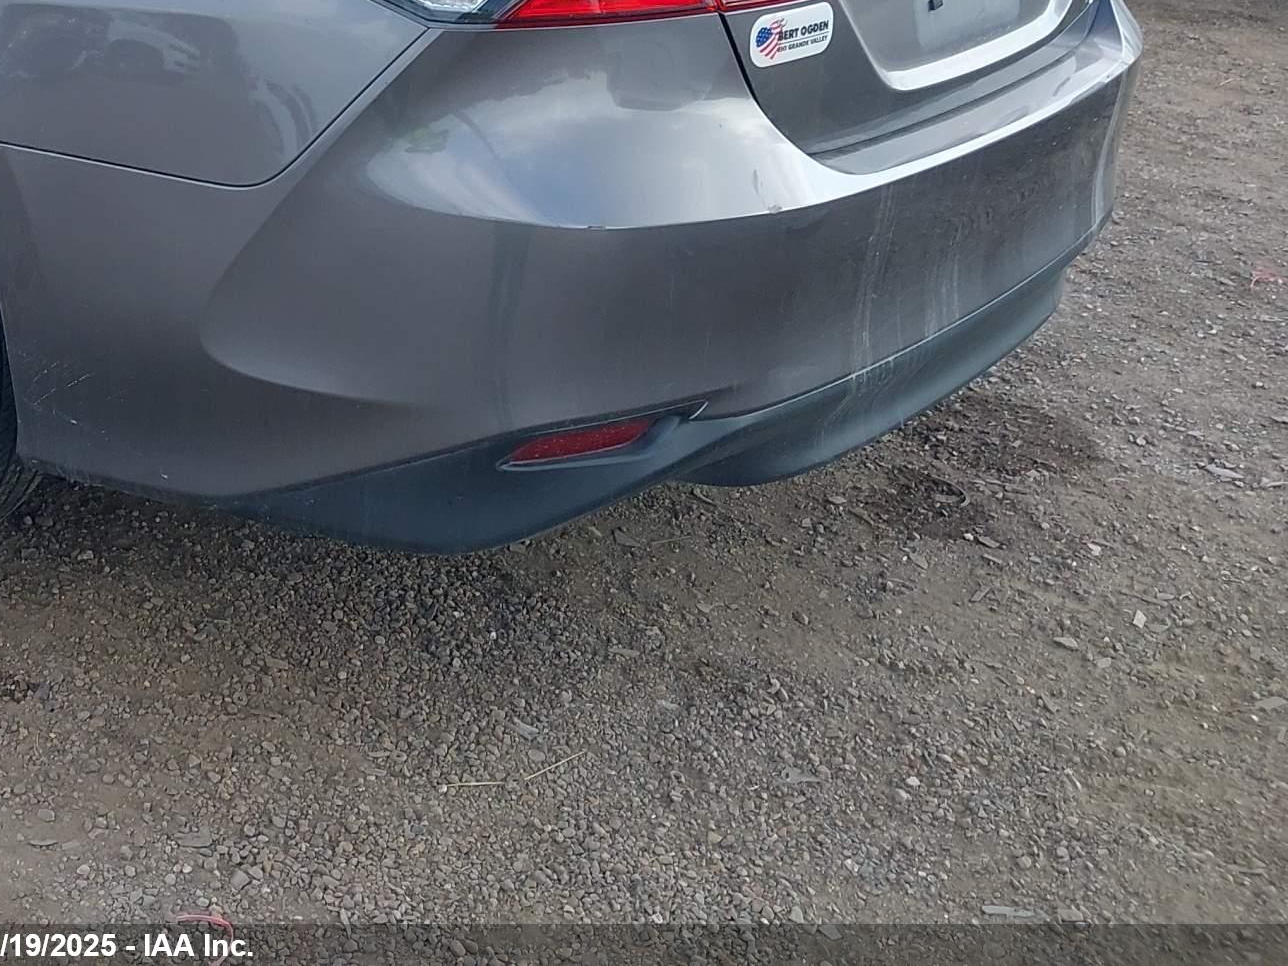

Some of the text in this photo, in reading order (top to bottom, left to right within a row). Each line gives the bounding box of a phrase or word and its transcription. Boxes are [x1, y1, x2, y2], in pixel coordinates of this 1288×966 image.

[778, 20, 829, 41] BERT OGDEN
[788, 38, 810, 50] GRANDE
[810, 35, 828, 45] VALLEY
